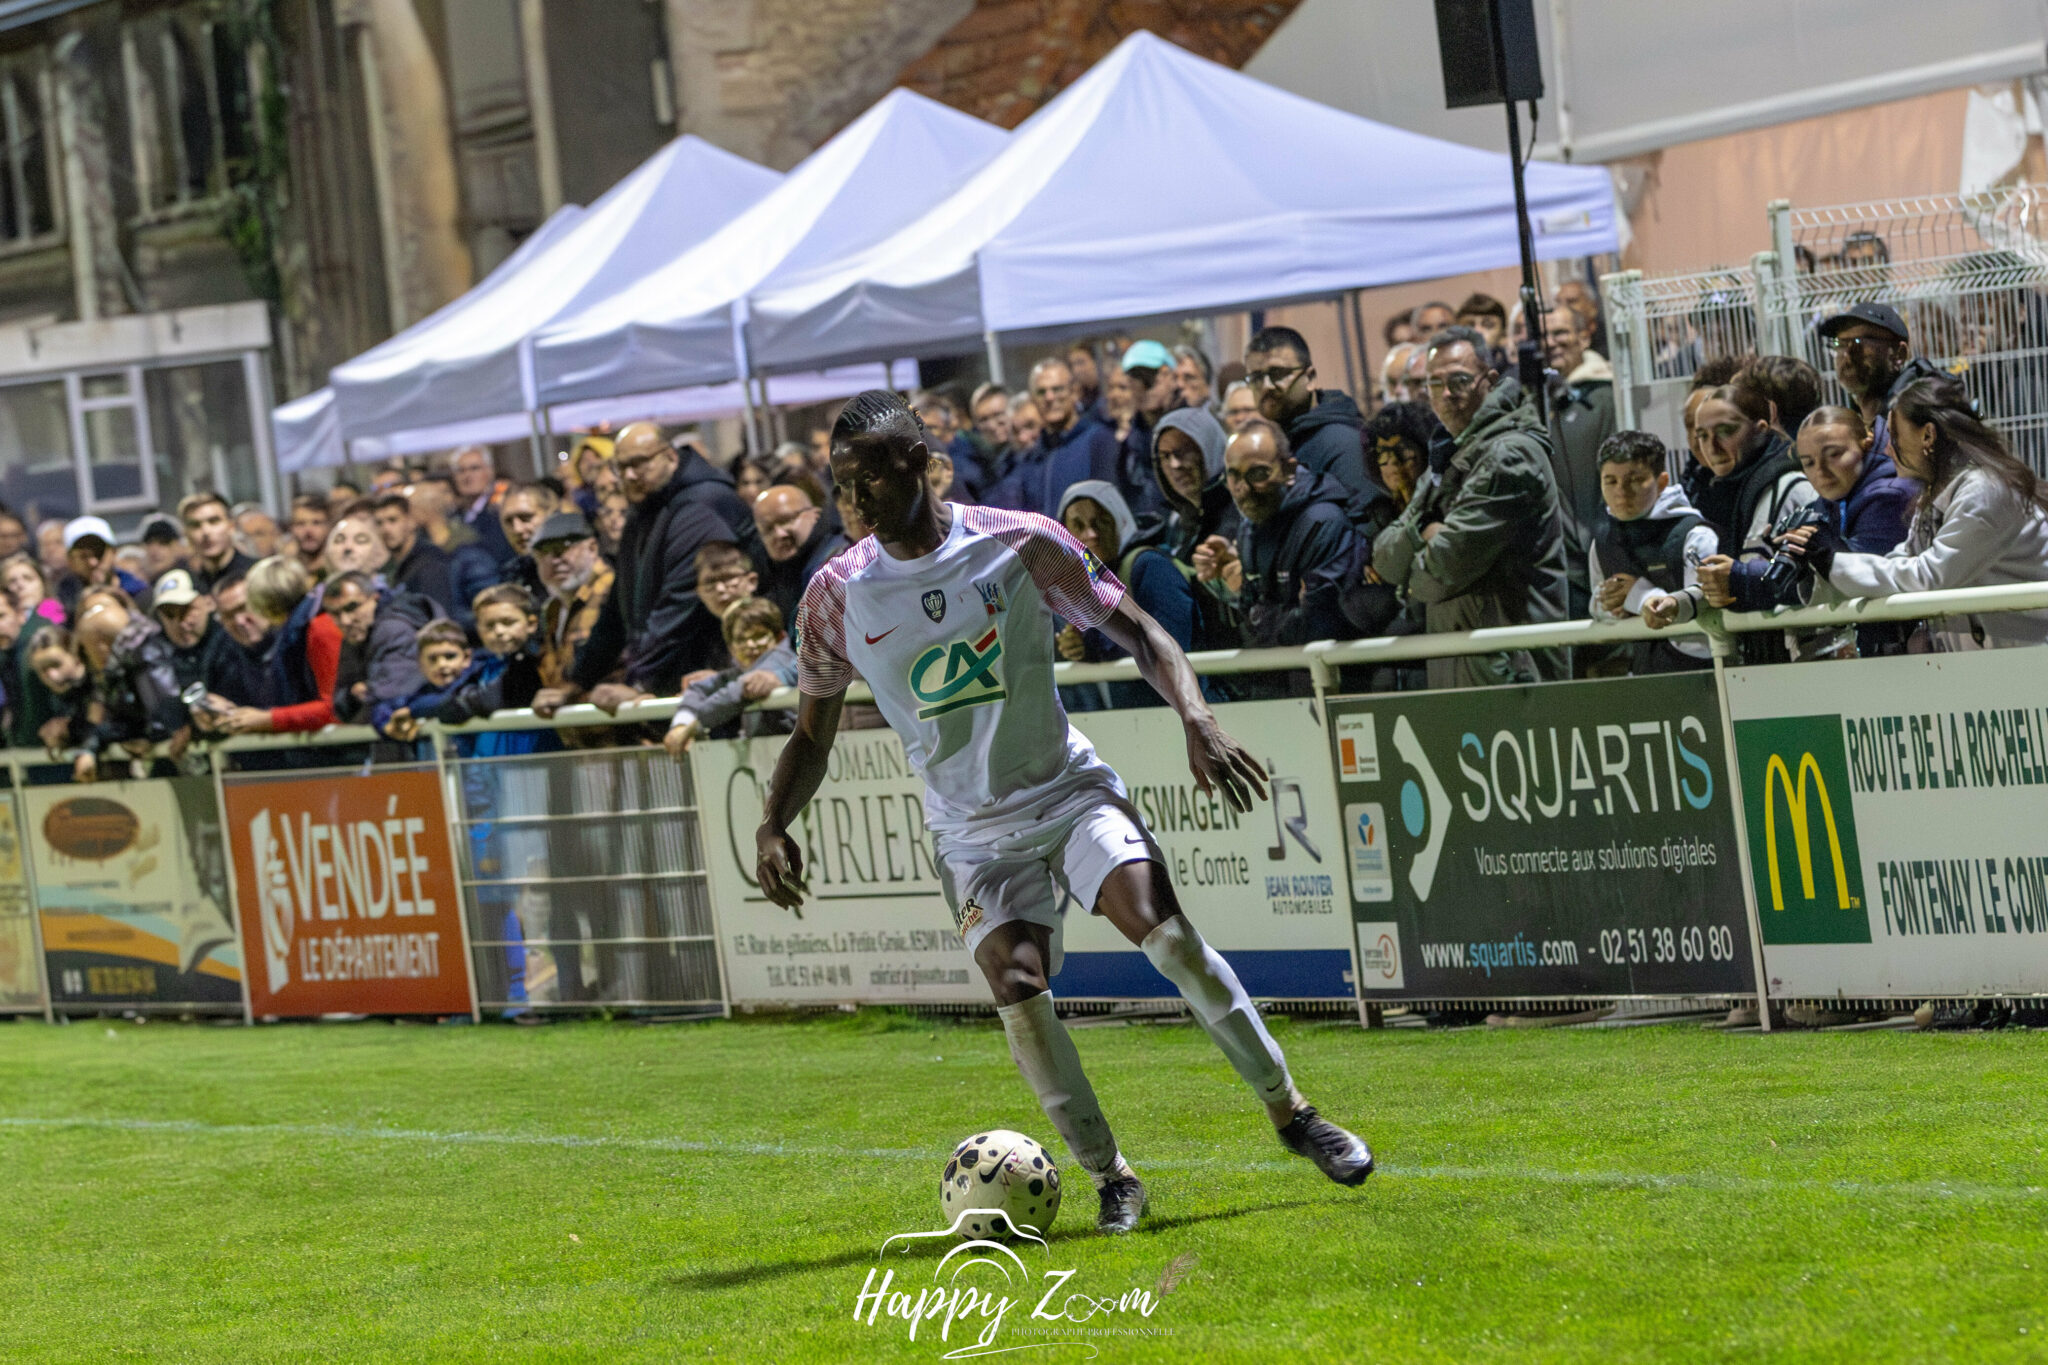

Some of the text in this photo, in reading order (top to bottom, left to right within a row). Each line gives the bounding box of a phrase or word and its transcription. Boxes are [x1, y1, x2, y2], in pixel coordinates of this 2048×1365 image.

[827, 740, 914, 784] OMAIN
[1457, 715, 1714, 824] SQUARTIS
[1846, 707, 2048, 793] ROUTE DE LA ROCHELL
[727, 766, 941, 887] CIRIER
[280, 794, 436, 922] VENDÉE
[1171, 847, 1250, 886] le Comte
[1474, 835, 1717, 876] Vous connecte aux solutions digitales
[1264, 874, 1334, 899] JEAN ROUYER
[1272, 899, 1333, 915] AUTOMOBILES
[1877, 858, 1976, 936] FONTENAY
[1975, 858, 2007, 934] LE
[299, 928, 440, 982] LE DÉPARTEMENT
[1420, 931, 1580, 978] www.squartis.com
[1600, 928, 1626, 965] 02
[1628, 928, 1649, 964] 51
[1652, 927, 1676, 963] 38
[1681, 926, 1705, 962] 60
[1709, 925, 1734, 961] 80
